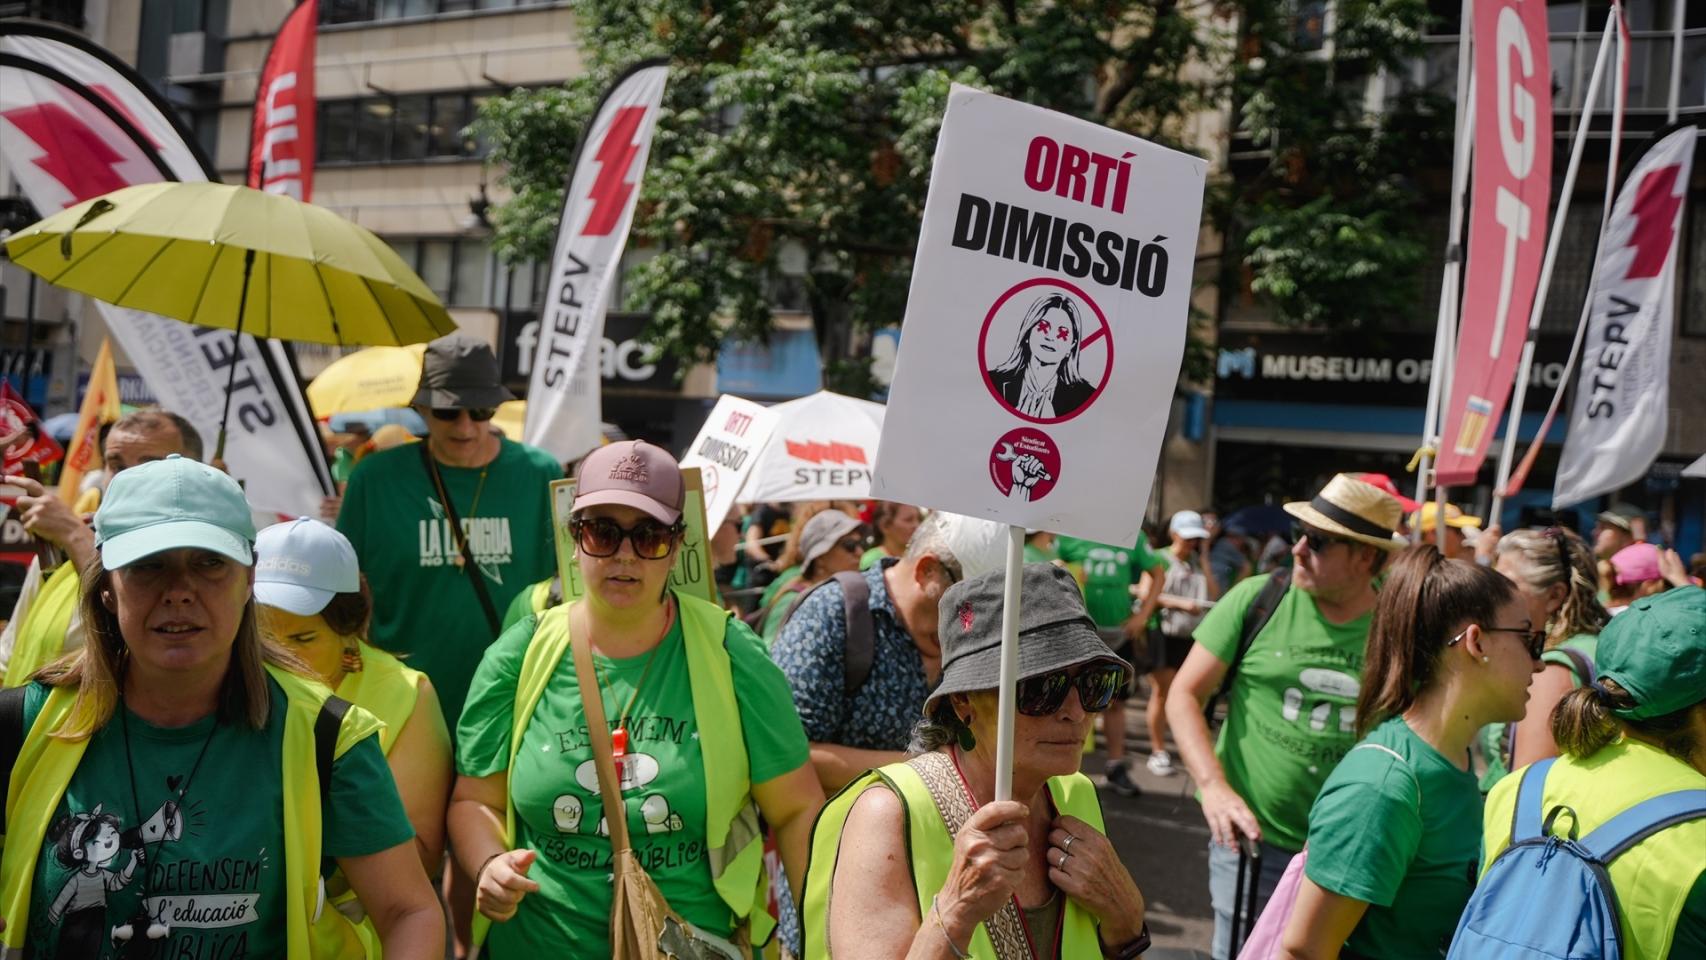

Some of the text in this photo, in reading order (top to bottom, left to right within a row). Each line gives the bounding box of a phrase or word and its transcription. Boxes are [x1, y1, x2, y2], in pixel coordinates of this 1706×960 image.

[1023, 136, 1138, 214] ORTÍ
[1490, 0, 1537, 359] GT
[951, 192, 1169, 297] DIMISSIÓ
[544, 252, 590, 388] STEPV
[516, 320, 656, 381] fac
[1262, 354, 1392, 382] MUSEUM
[1587, 294, 1640, 418] STEPV
[419, 518, 442, 557] LA
[420, 557, 444, 567] NO
[256, 557, 311, 577] adidas
[152, 858, 260, 891] DEFENSEM
[149, 898, 249, 924] l'educació
